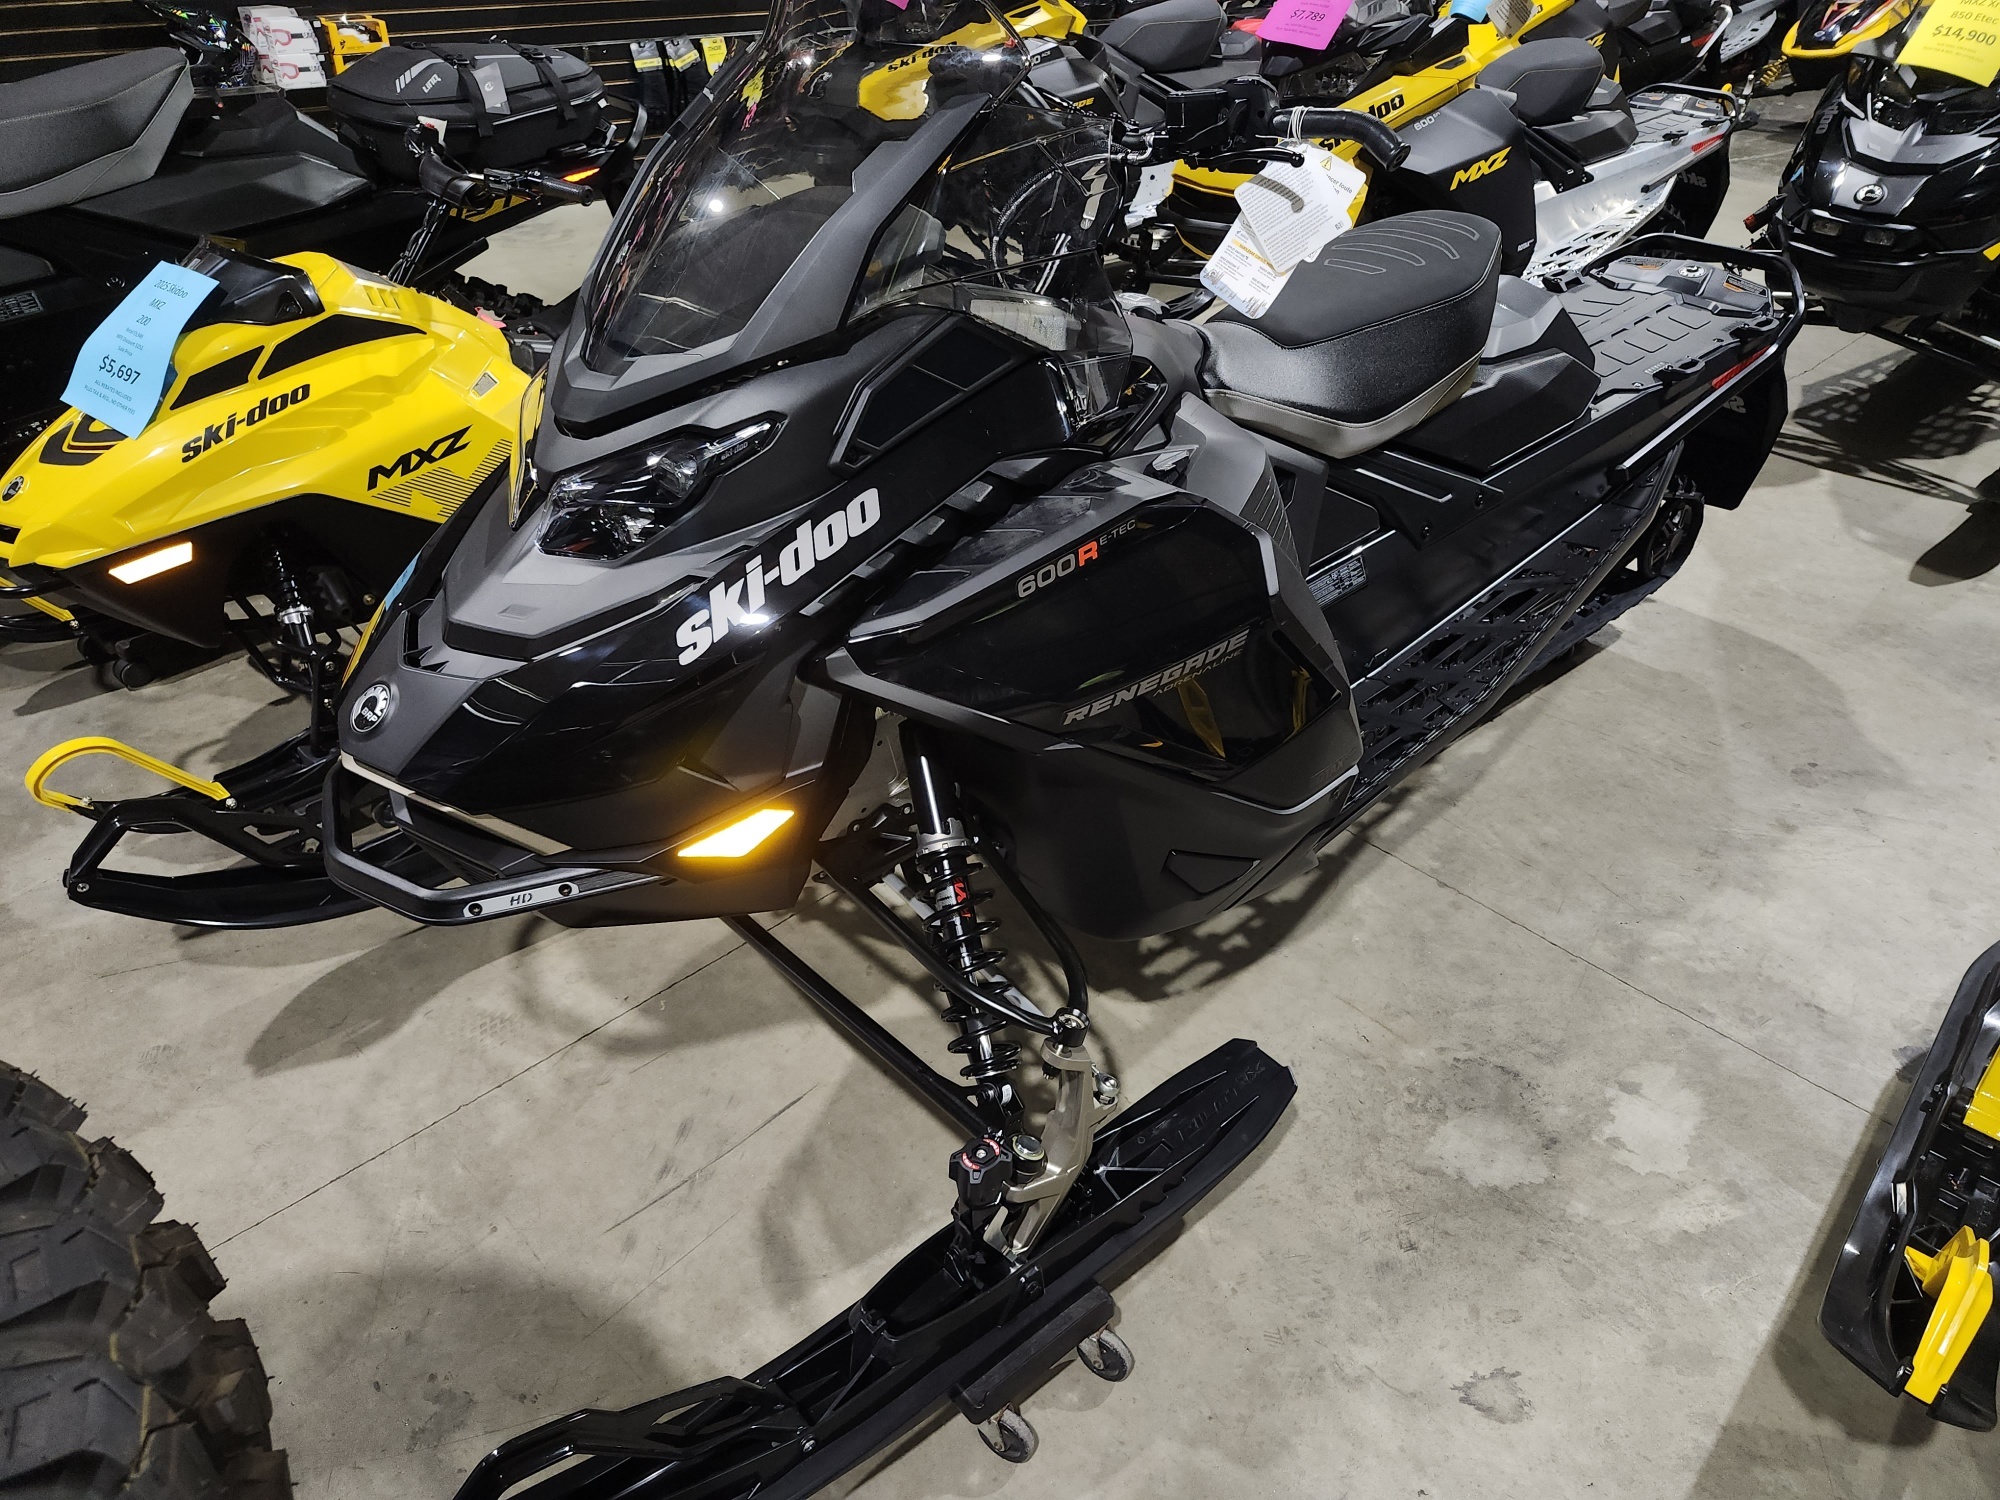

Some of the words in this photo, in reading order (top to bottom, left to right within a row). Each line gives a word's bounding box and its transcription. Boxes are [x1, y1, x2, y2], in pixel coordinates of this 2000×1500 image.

[1290, 9, 1326, 22] $7,789
[1950, 10, 1973, 20] 850
[1974, 12, 1999, 25] Etec
[1932, 24, 1997, 46] $14,900
[1413, 115, 1435, 131] 600
[1450, 146, 1512, 192] MXZ
[153, 279, 169, 291] 2025
[167, 283, 189, 299] Skidoo
[149, 298, 167, 310] MXZ
[136, 314, 152, 327] 200
[99, 354, 141, 385] $5,697
[181, 383, 311, 464] ski-doo
[366, 424, 474, 491] MXZ
[1017, 540, 1099, 598] 600R
[1099, 519, 1136, 546] E-TEC
[675, 487, 881, 666] ski-doo
[1063, 628, 1250, 727] RENEGADE
[1152, 648, 1243, 698] ADRENALINE
[360, 706, 378, 724] BRP
[510, 892, 533, 908] HD
